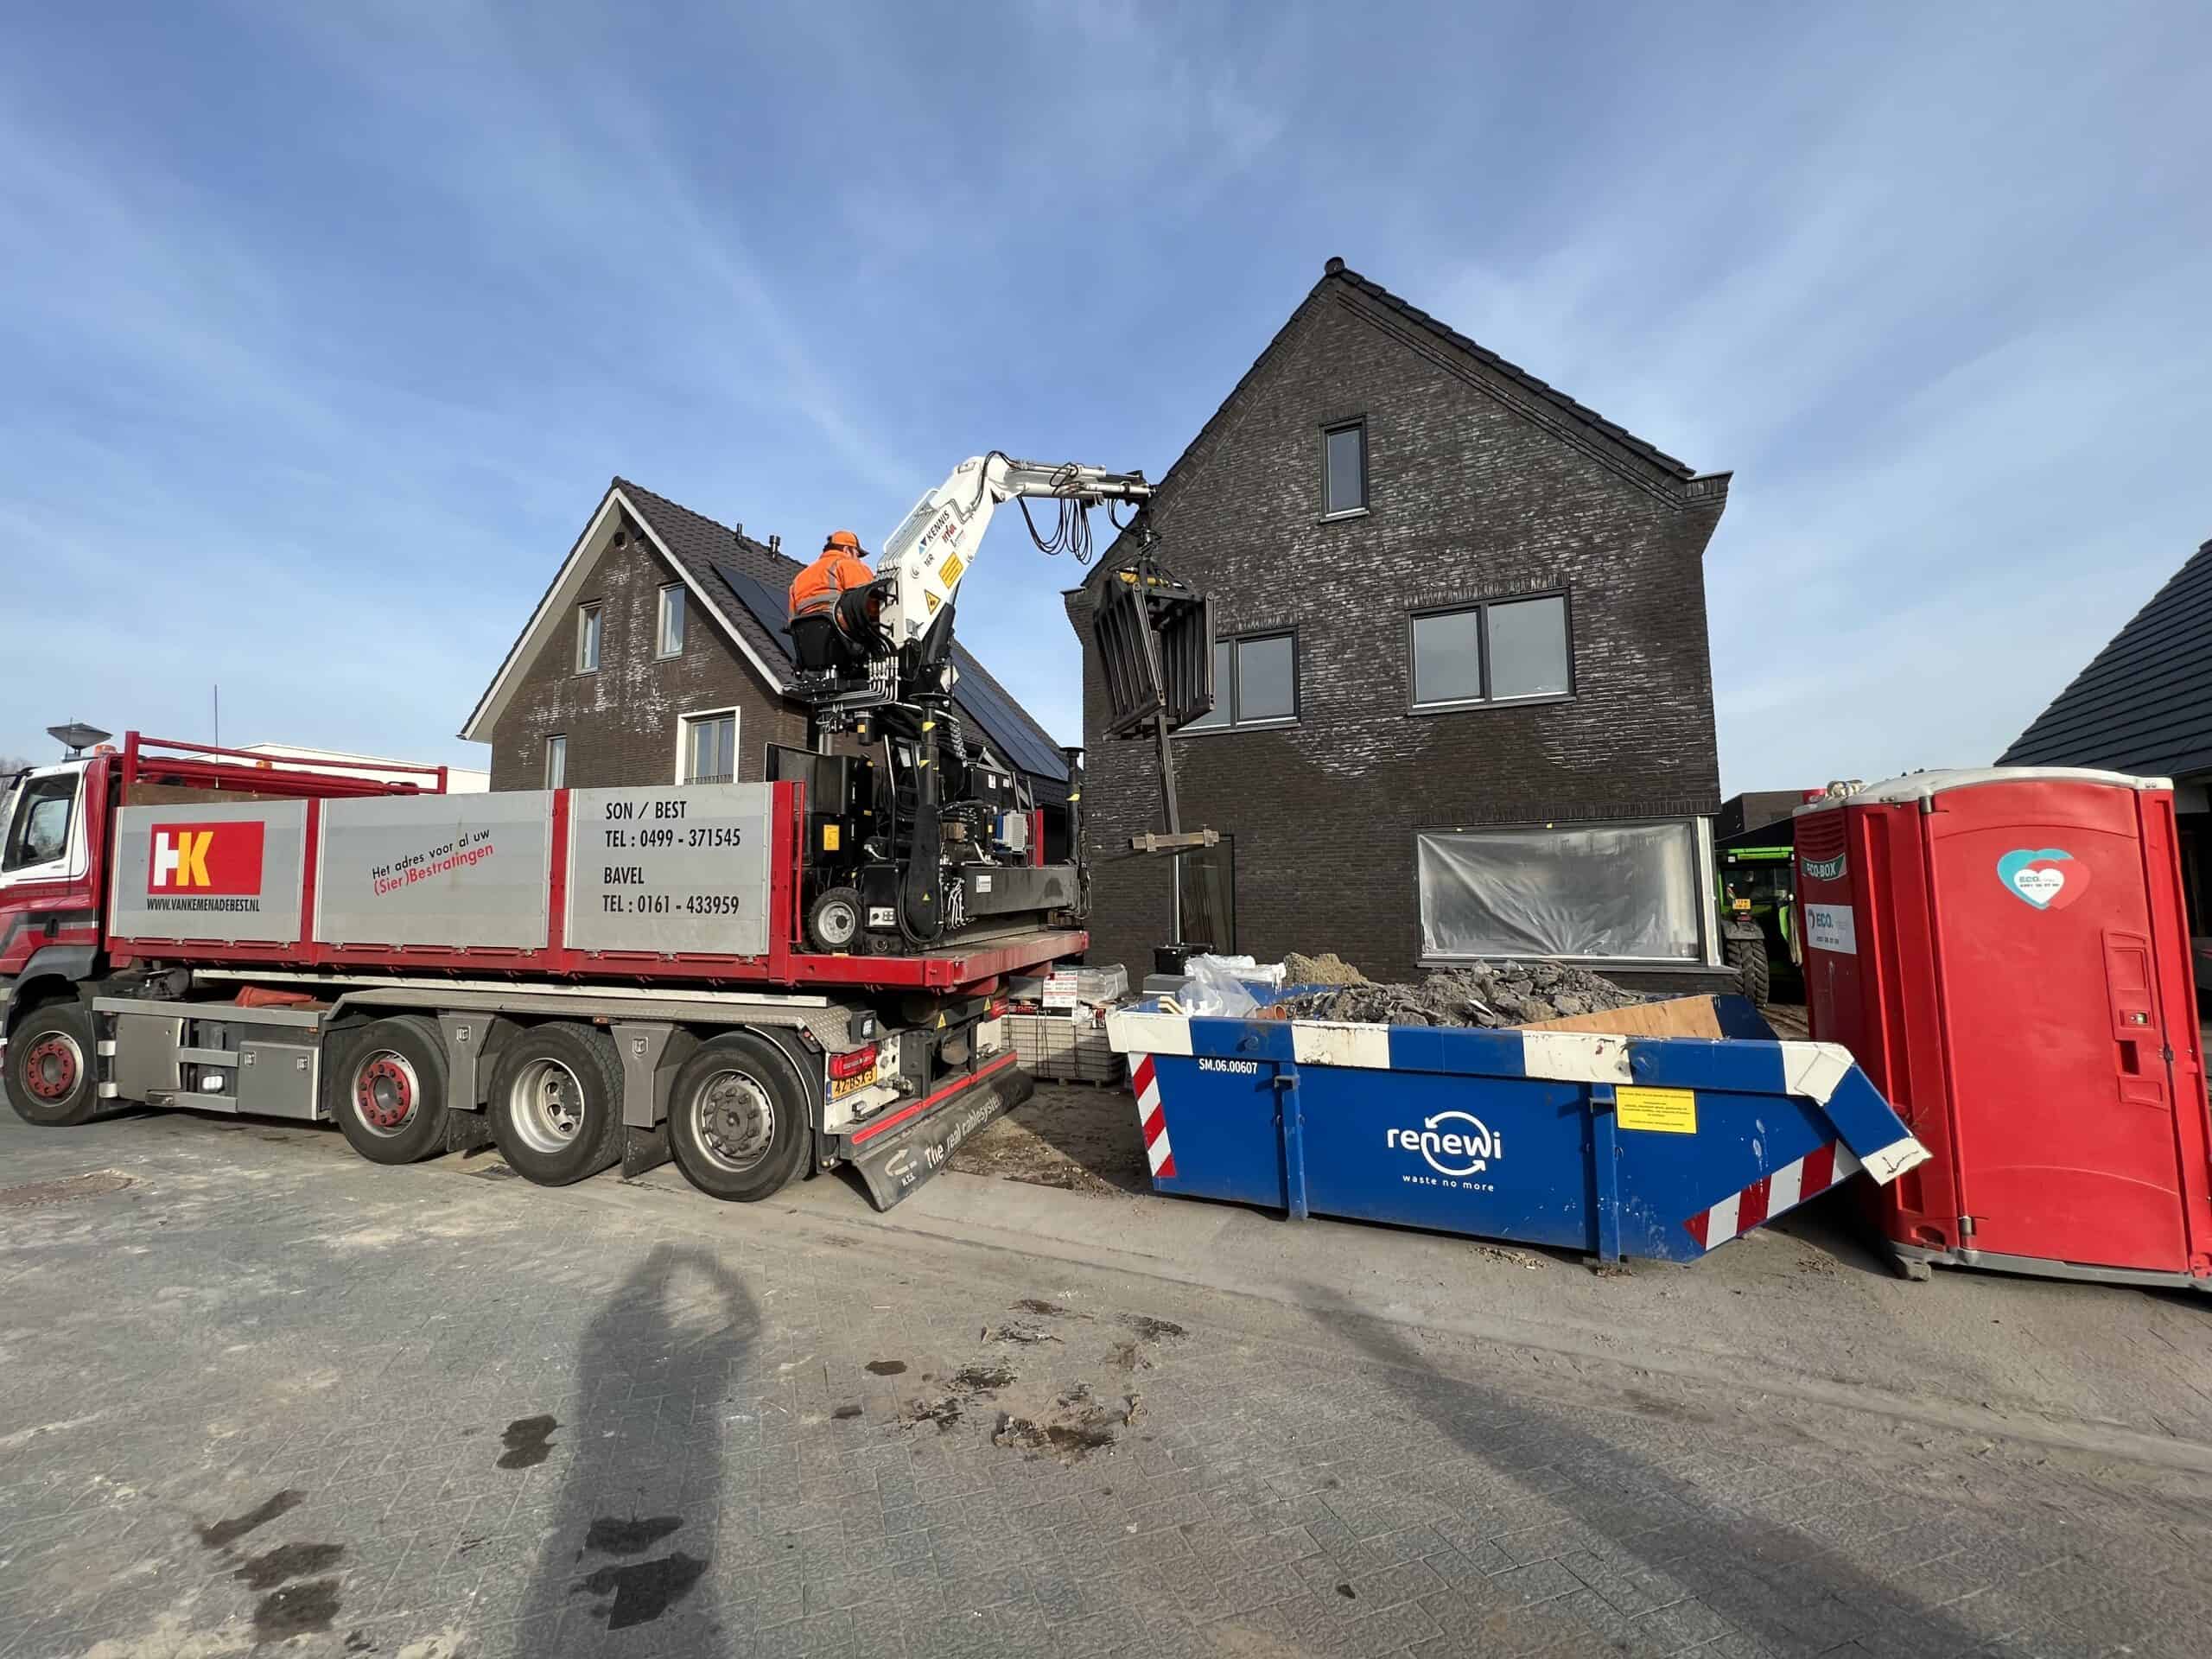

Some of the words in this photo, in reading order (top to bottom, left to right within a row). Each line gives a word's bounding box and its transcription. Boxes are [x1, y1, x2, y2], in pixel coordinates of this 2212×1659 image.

[926, 510, 950, 542] KENNIS
[606, 802, 633, 819] SON
[638, 802, 649, 819] /
[655, 801, 687, 818] BEST
[606, 830, 626, 847] TEL
[640, 830, 674, 847] 0499
[689, 829, 741, 847] 371545
[153, 831, 214, 887] HK
[372, 865, 390, 880] Het
[395, 855, 424, 872] adres
[429, 843, 453, 858] voor
[459, 833, 469, 848] al
[474, 830, 490, 842] uw
[374, 844, 493, 896] (Sier)Bestratingen
[604, 867, 645, 885] BAVEL
[147, 898, 261, 912] WWW.VANKEMENADEBEST.NL
[602, 894, 624, 912] TEL
[638, 895, 670, 913] 0161
[686, 895, 740, 914] 433959
[1198, 1058, 1258, 1075] SM.06.00607
[925, 1142, 944, 1169] The
[946, 1123, 963, 1153] real
[1387, 1128, 1502, 1160] renewi
[1402, 1175, 1437, 1185] waste
[1442, 1179, 1458, 1188] no
[1463, 1181, 1494, 1192] more
